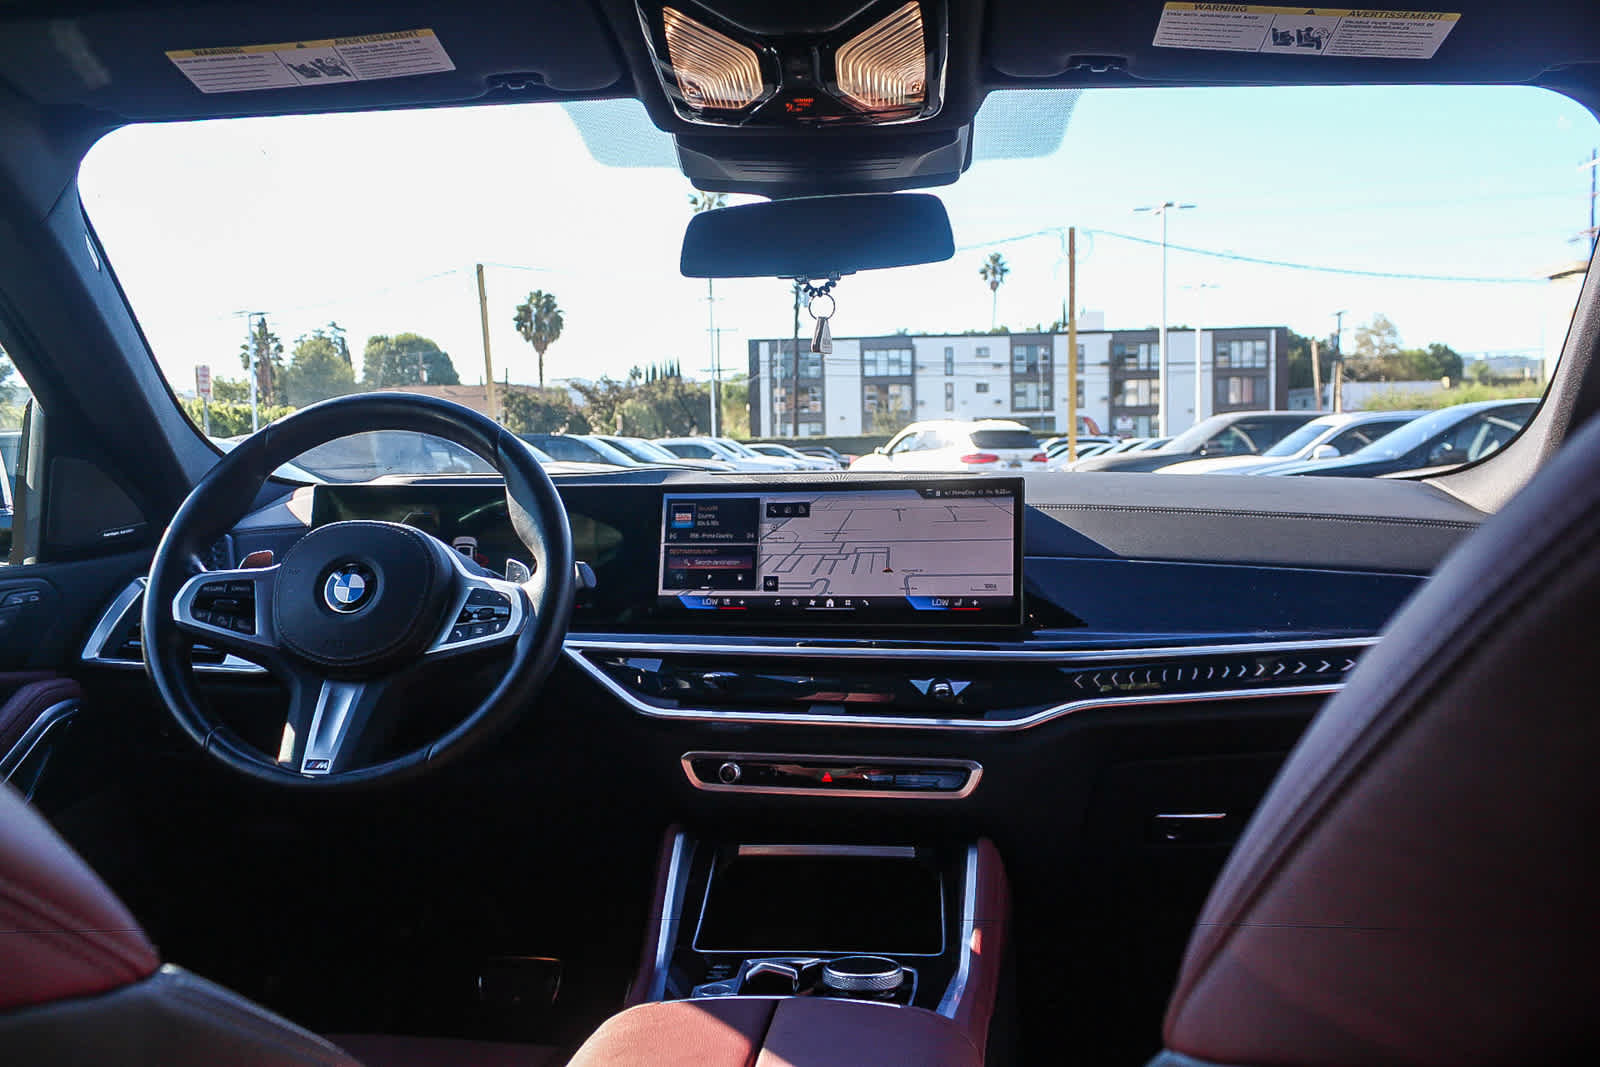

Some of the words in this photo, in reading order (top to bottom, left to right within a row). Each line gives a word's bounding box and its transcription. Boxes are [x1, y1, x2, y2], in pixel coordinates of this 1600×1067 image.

[1194, 2, 1248, 13] WARNING
[1346, 10, 1444, 21] AVERTISSEMENT
[702, 598, 718, 606] LOW
[931, 599, 949, 607] LOW
